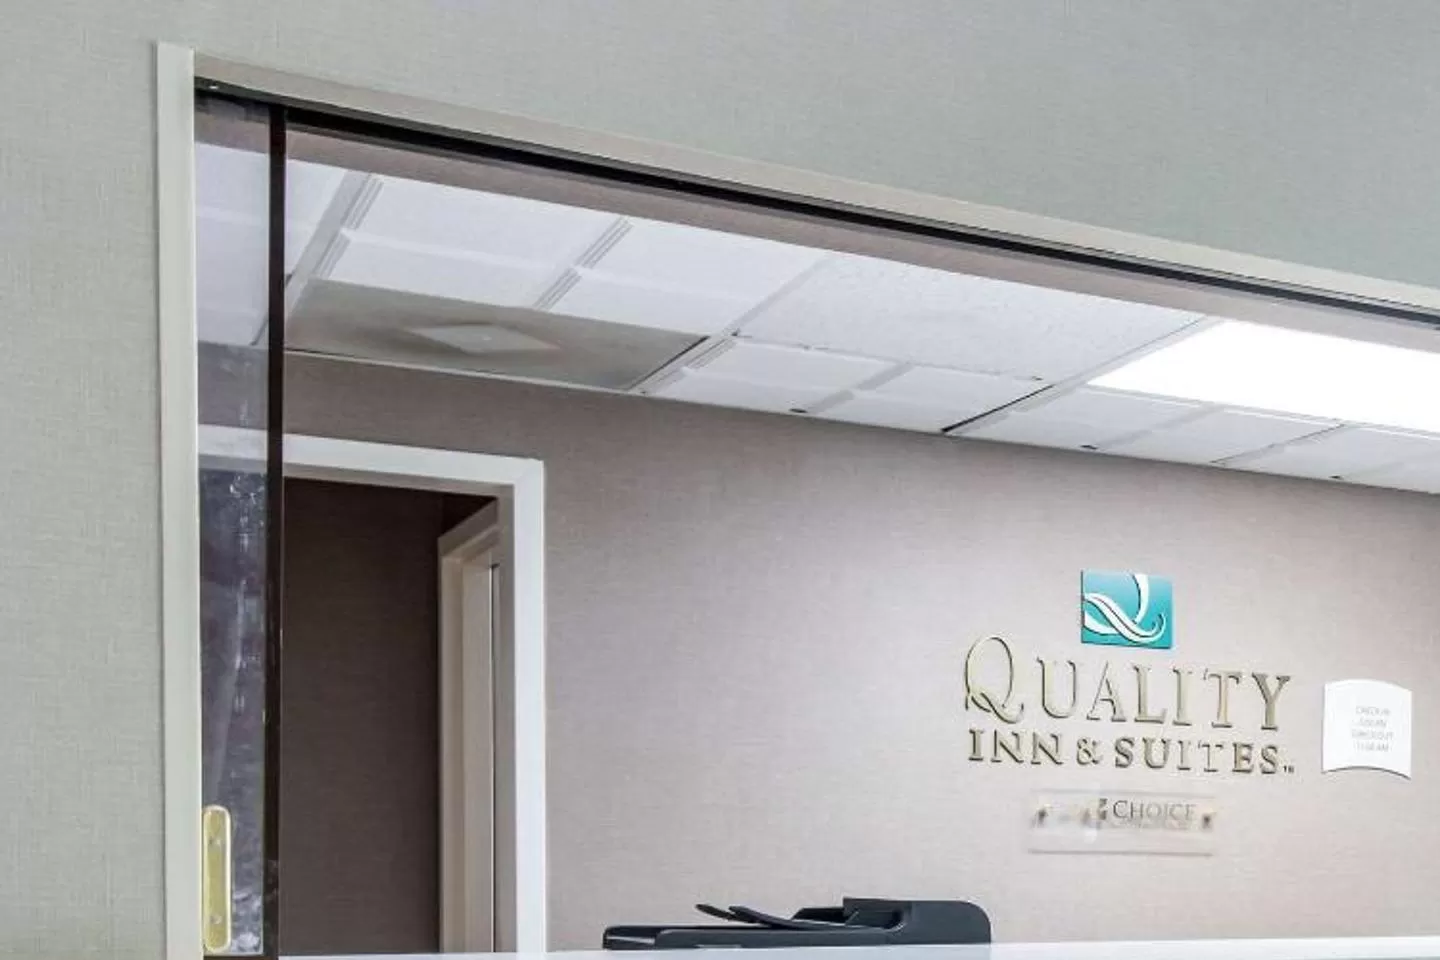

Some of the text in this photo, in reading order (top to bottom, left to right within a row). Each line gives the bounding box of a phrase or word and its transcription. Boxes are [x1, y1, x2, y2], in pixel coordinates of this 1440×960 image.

[964, 636, 1292, 731] QUALITY
[968, 729, 1064, 765] INN
[1076, 737, 1102, 765] &
[1114, 735, 1278, 774] SUITES
[1112, 799, 1196, 822] CHOICE
